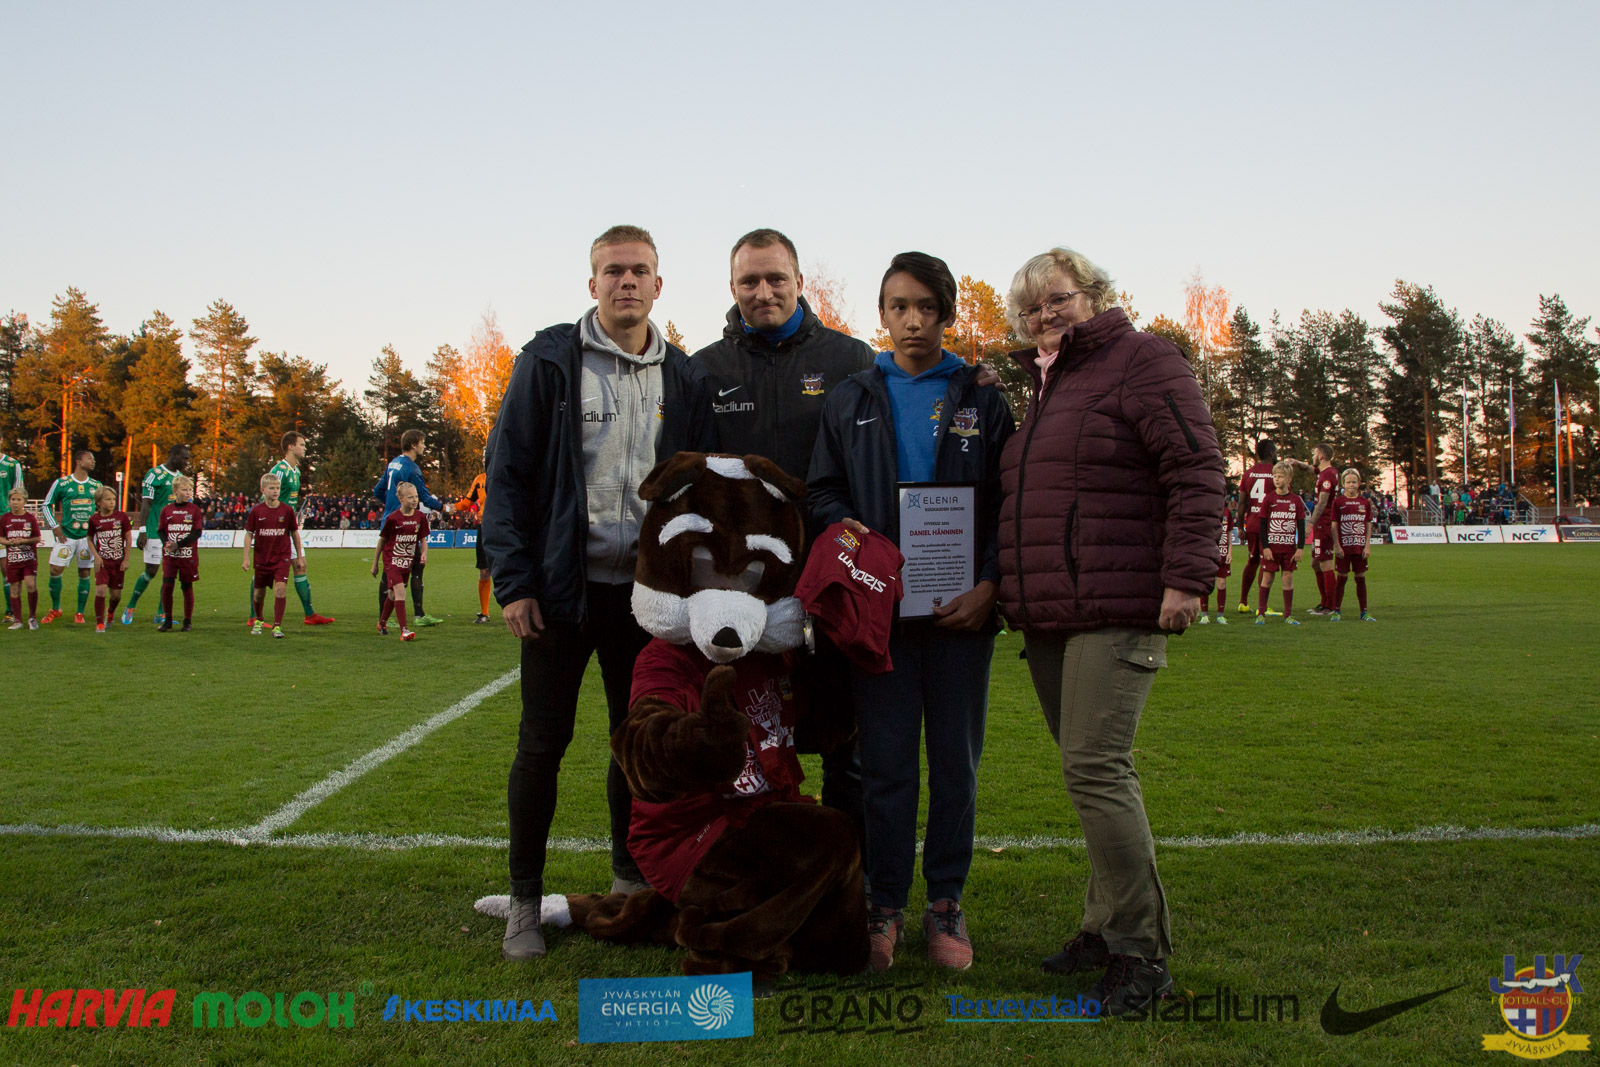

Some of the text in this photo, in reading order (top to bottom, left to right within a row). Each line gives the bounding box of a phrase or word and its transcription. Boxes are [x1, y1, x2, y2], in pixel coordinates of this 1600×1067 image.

[581, 411, 617, 422] dium
[961, 438, 969, 452] 2
[387, 470, 394, 490] 1
[1250, 478, 1266, 504] 4
[923, 496, 959, 505] ELENIA
[1270, 511, 1296, 519] HARVIA
[259, 528, 285, 536] HARVIA
[932, 528, 964, 536] HÄNNINEN
[311, 535, 334, 543] JYKES
[426, 533, 447, 543] k.fi
[1457, 533, 1484, 541] NCC
[1512, 533, 1539, 541] NCC
[8, 551, 35, 560] GRANO
[837, 551, 887, 594] stadium
